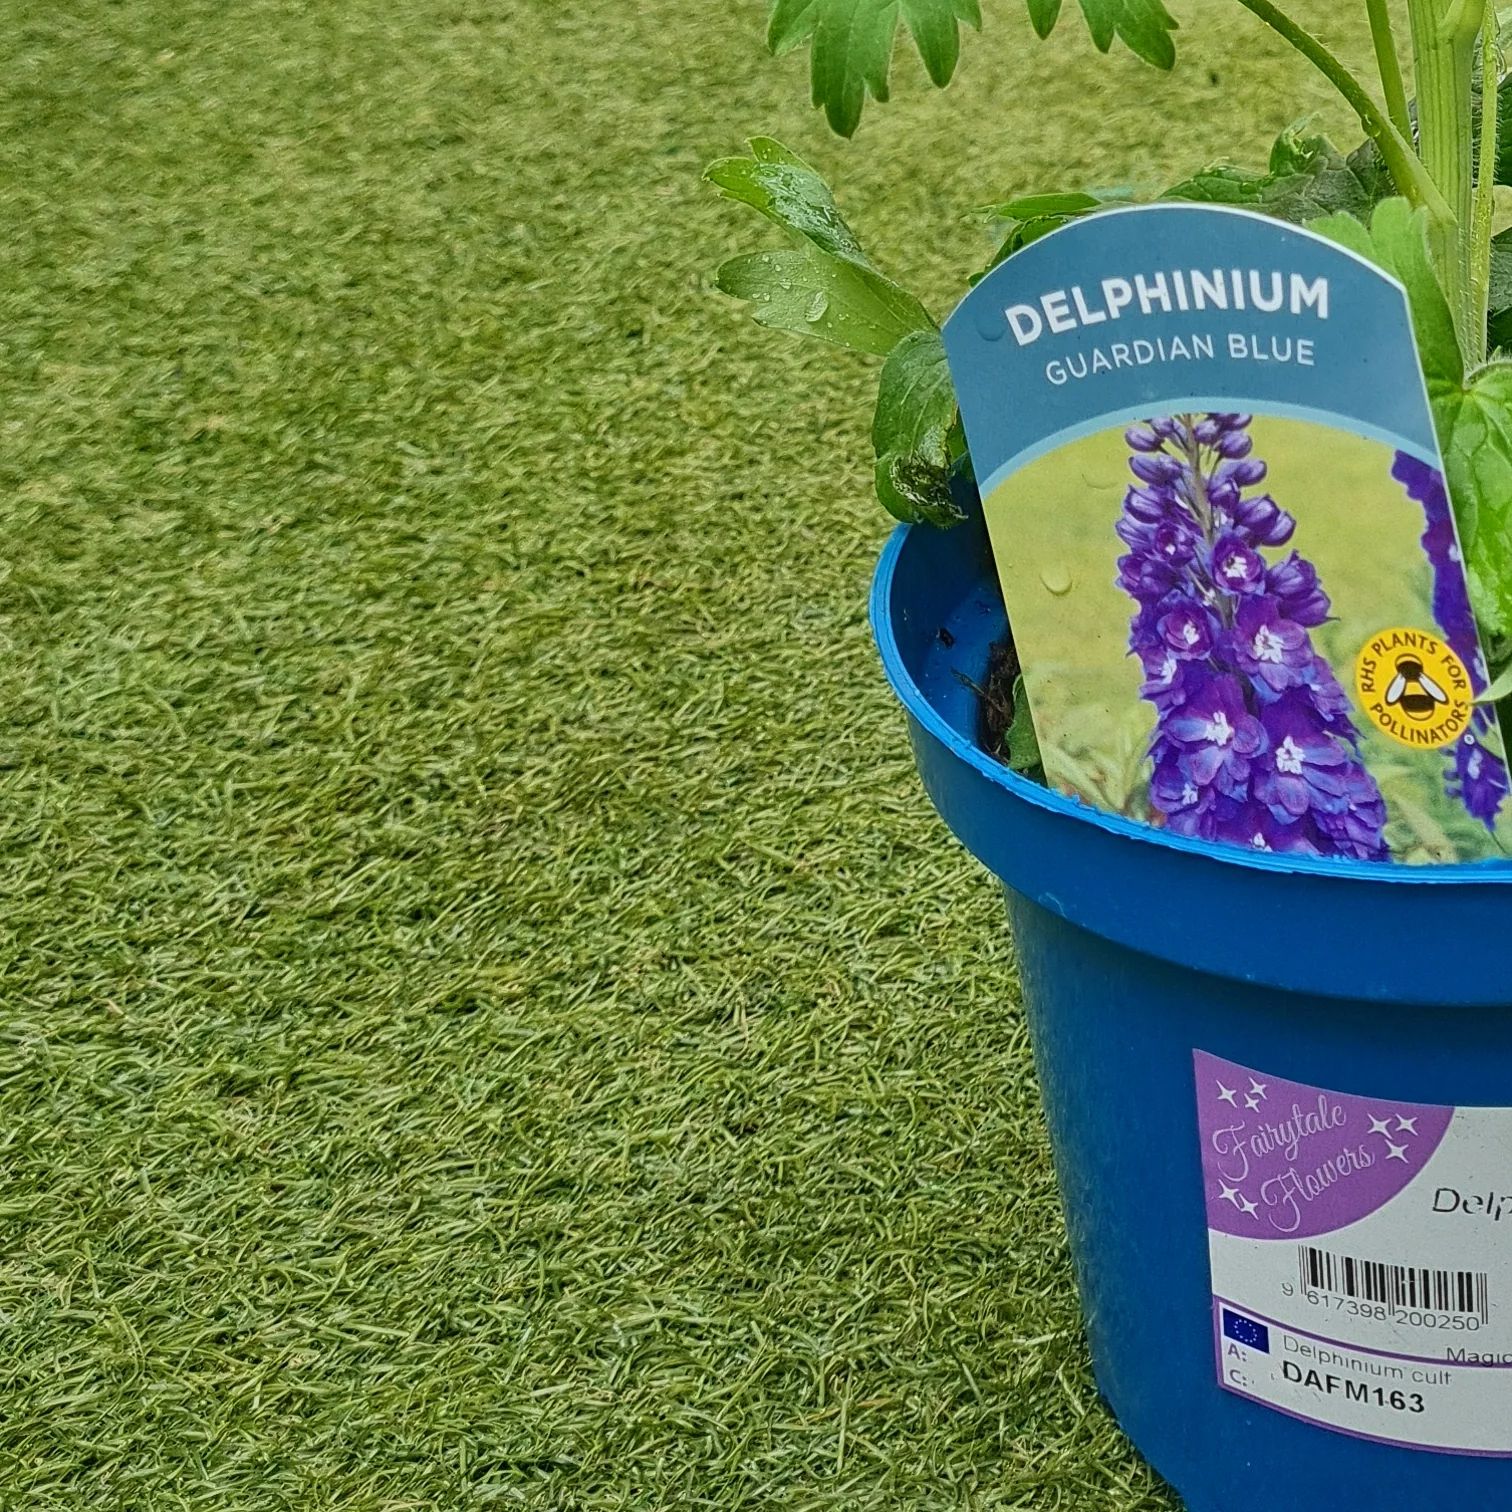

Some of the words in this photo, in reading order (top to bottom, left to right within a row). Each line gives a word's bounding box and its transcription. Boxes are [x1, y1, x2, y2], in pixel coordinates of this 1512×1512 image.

[1005, 269, 1328, 346] DELPHINIUM
[1046, 334, 1215, 385] GUARDIAN
[1227, 333, 1315, 366] BLUE
[1360, 657, 1376, 693] RHS
[1371, 632, 1438, 657] PLANTS
[1441, 654, 1467, 690] FOR
[1369, 699, 1469, 745] POLLINATORS
[1212, 1094, 1347, 1182] Fairytale
[1260, 1144, 1375, 1232] Flowers
[1281, 1283, 1294, 1296] 9
[1307, 1291, 1387, 1321] 617398
[1396, 1310, 1480, 1331] 200250
[1227, 1344, 1248, 1362] A:
[1283, 1335, 1403, 1379] Delphinium
[1411, 1371, 1452, 1385] cult
[1229, 1369, 1248, 1386] C:
[1282, 1360, 1425, 1413] DAFM163
